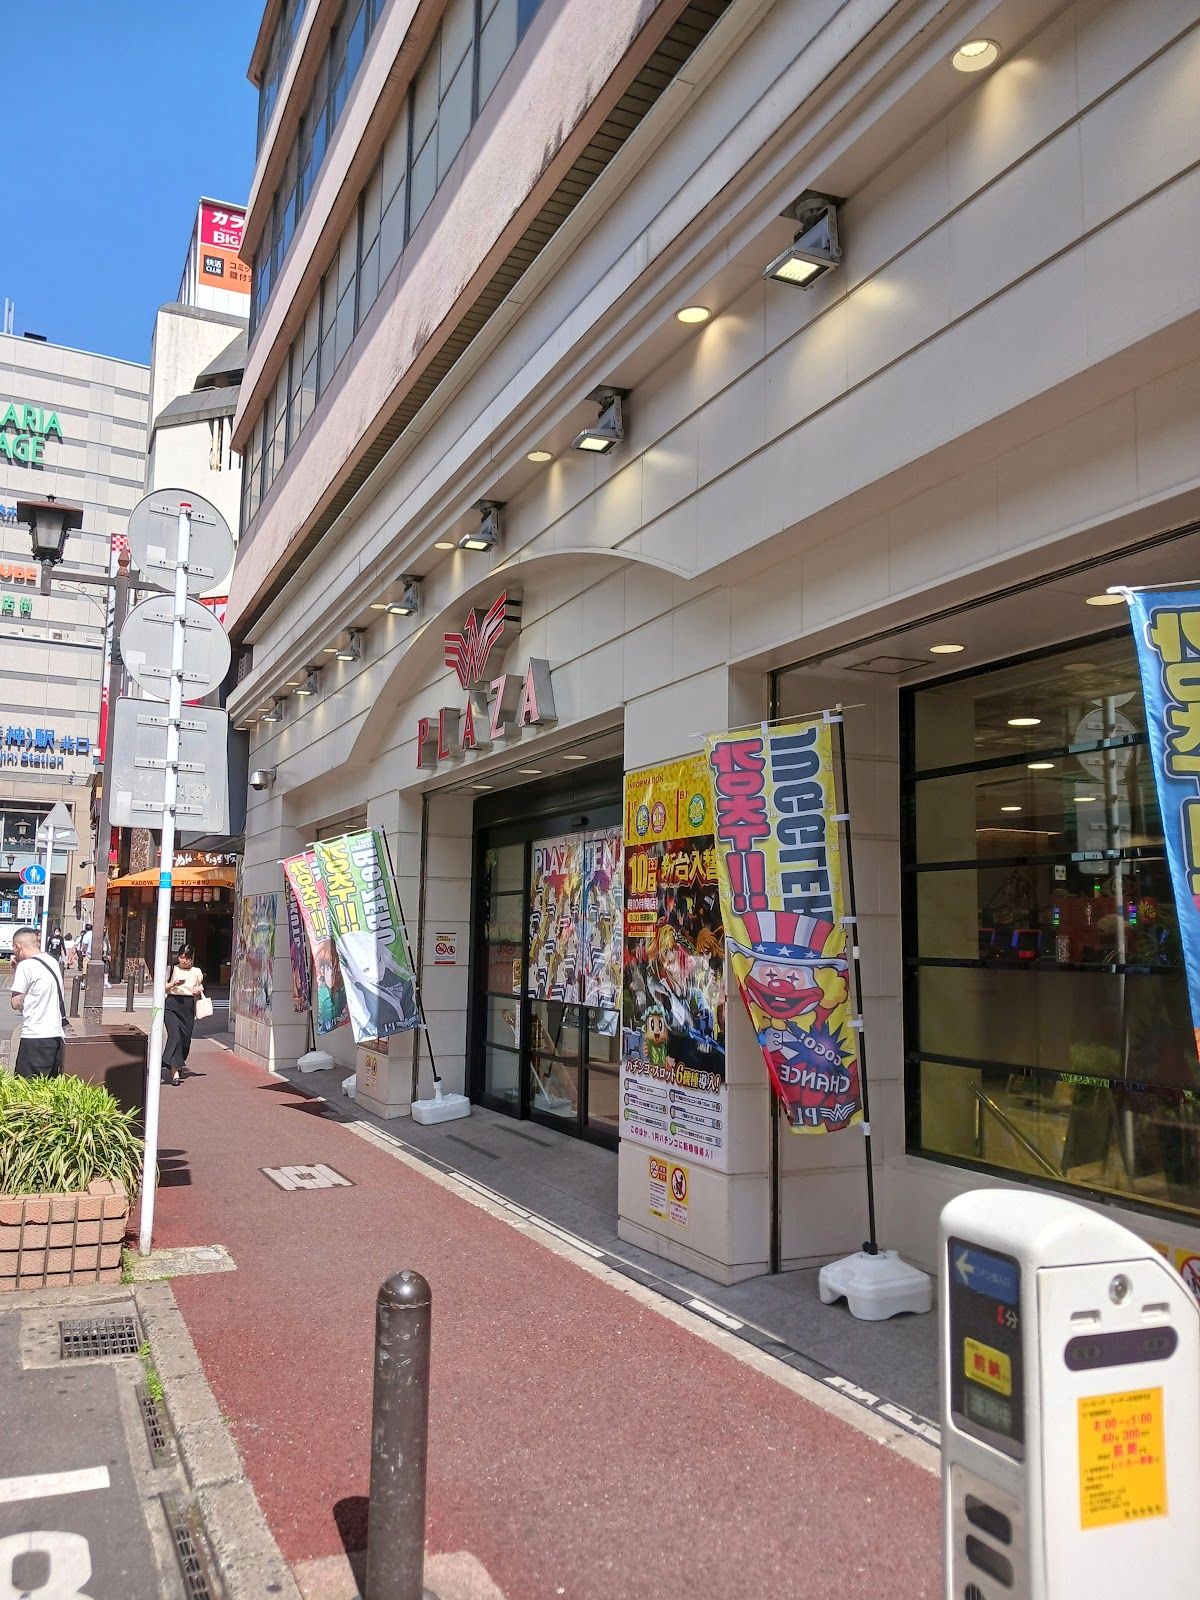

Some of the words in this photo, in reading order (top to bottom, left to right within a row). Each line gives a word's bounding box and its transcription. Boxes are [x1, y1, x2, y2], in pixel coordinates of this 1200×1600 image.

[211, 211, 245, 229] カラ
[213, 231, 239, 245] BIG
[0, 402, 63, 438] ARIA
[416, 656, 556, 770] PLAZA
[0, 726, 55, 749] 神)駅
[21, 752, 64, 767] Station
[627, 775, 664, 790] INFORMATION
